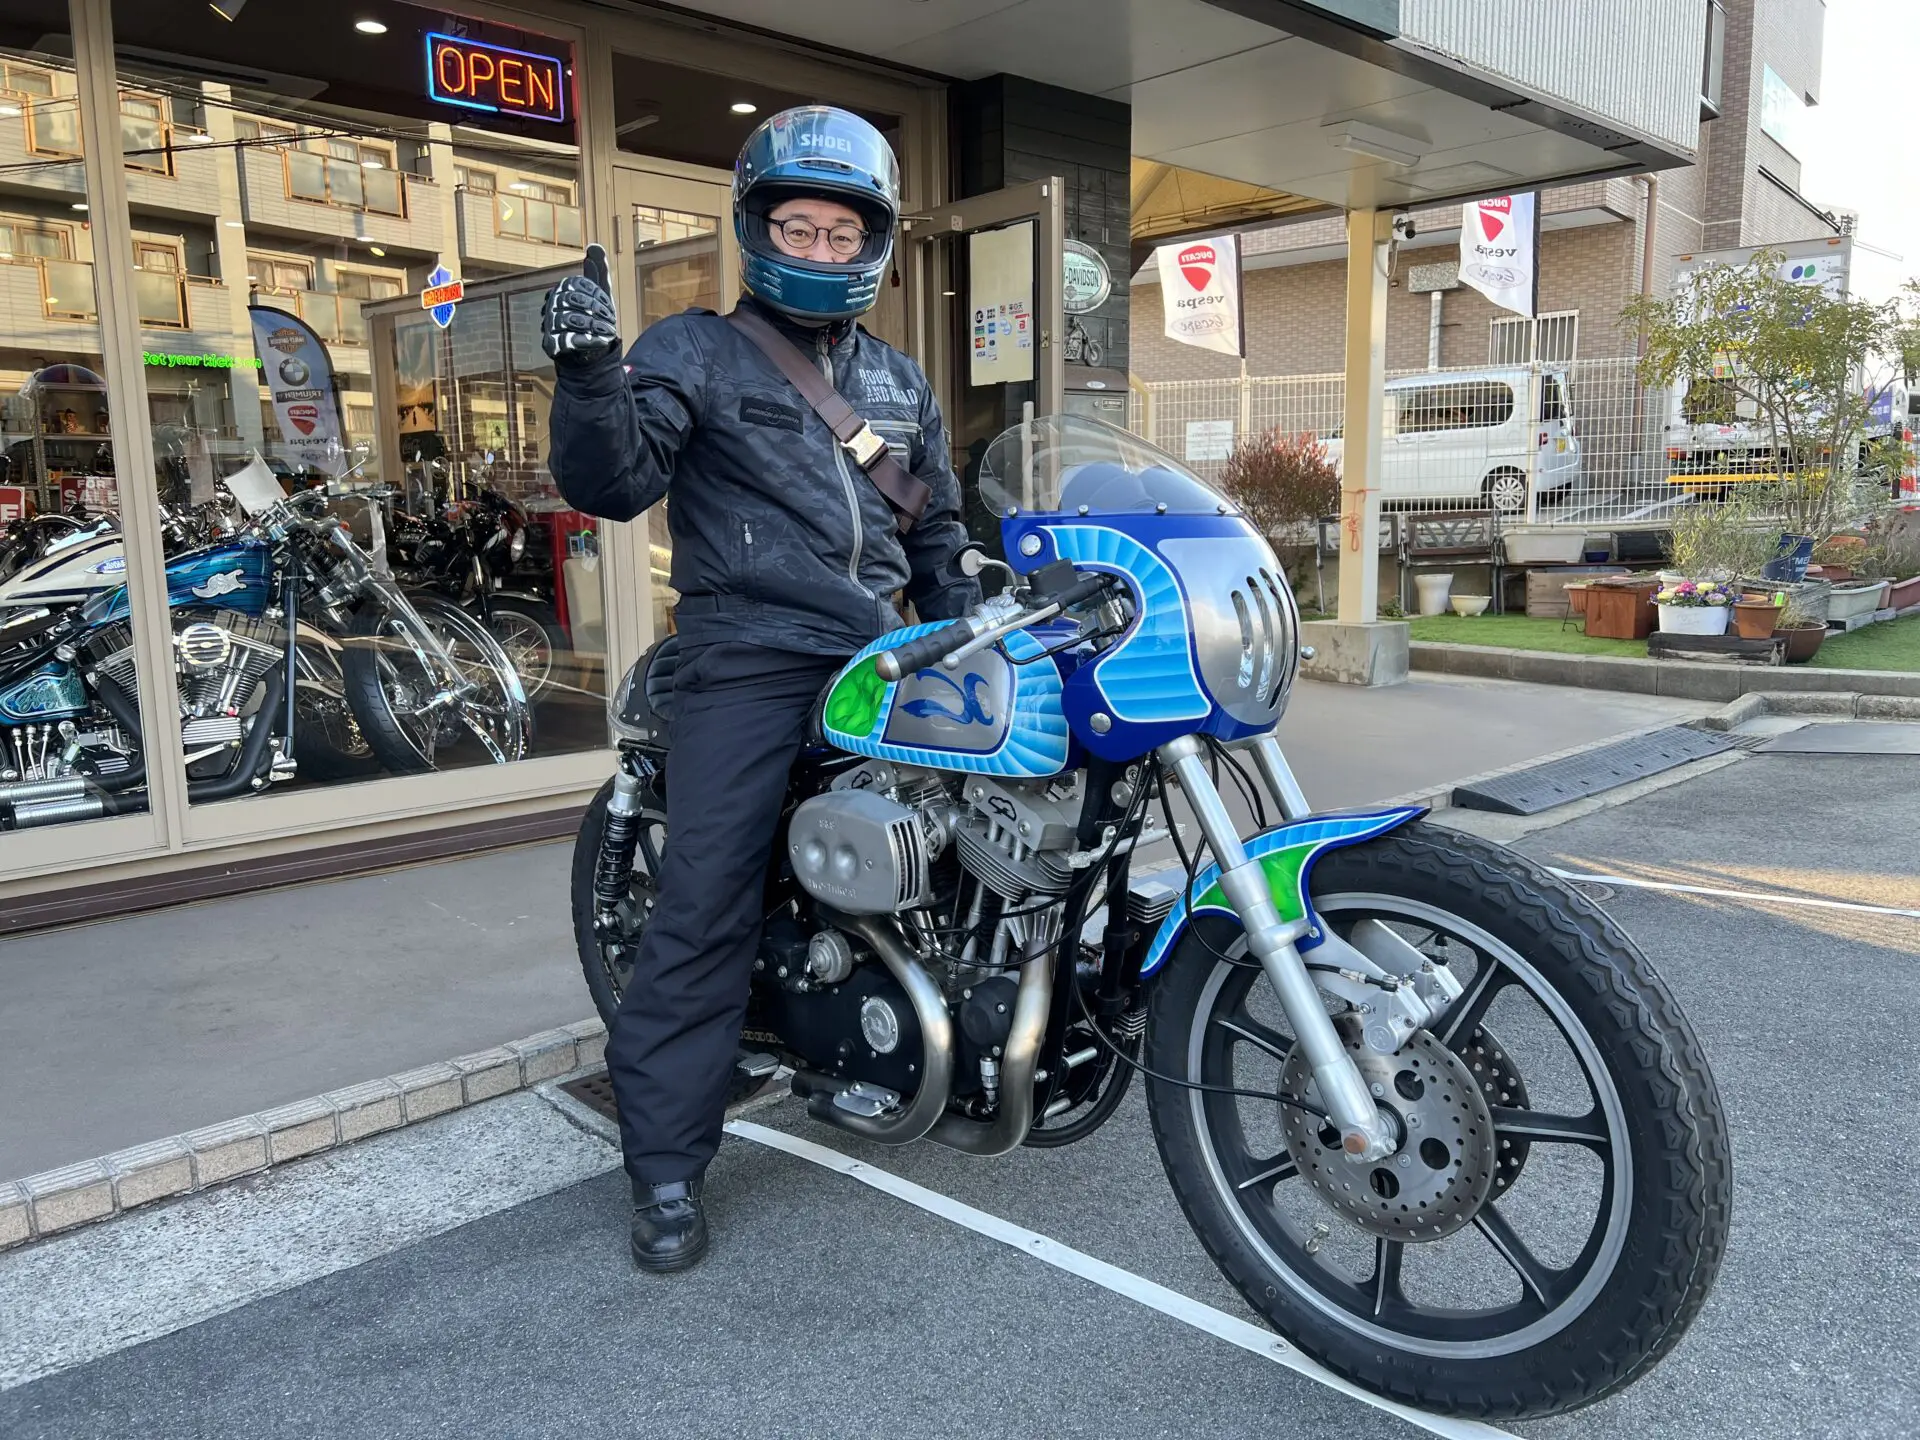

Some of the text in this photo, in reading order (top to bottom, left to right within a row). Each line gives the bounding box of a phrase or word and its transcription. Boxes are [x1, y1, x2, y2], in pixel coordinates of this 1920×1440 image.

[439, 47, 553, 110] OPEN
[800, 133, 851, 153] SHOEI
[168, 354, 202, 367] your
[866, 385, 918, 406] AND RAD
[77, 479, 106, 489] FOR
[63, 489, 118, 505] SALE
